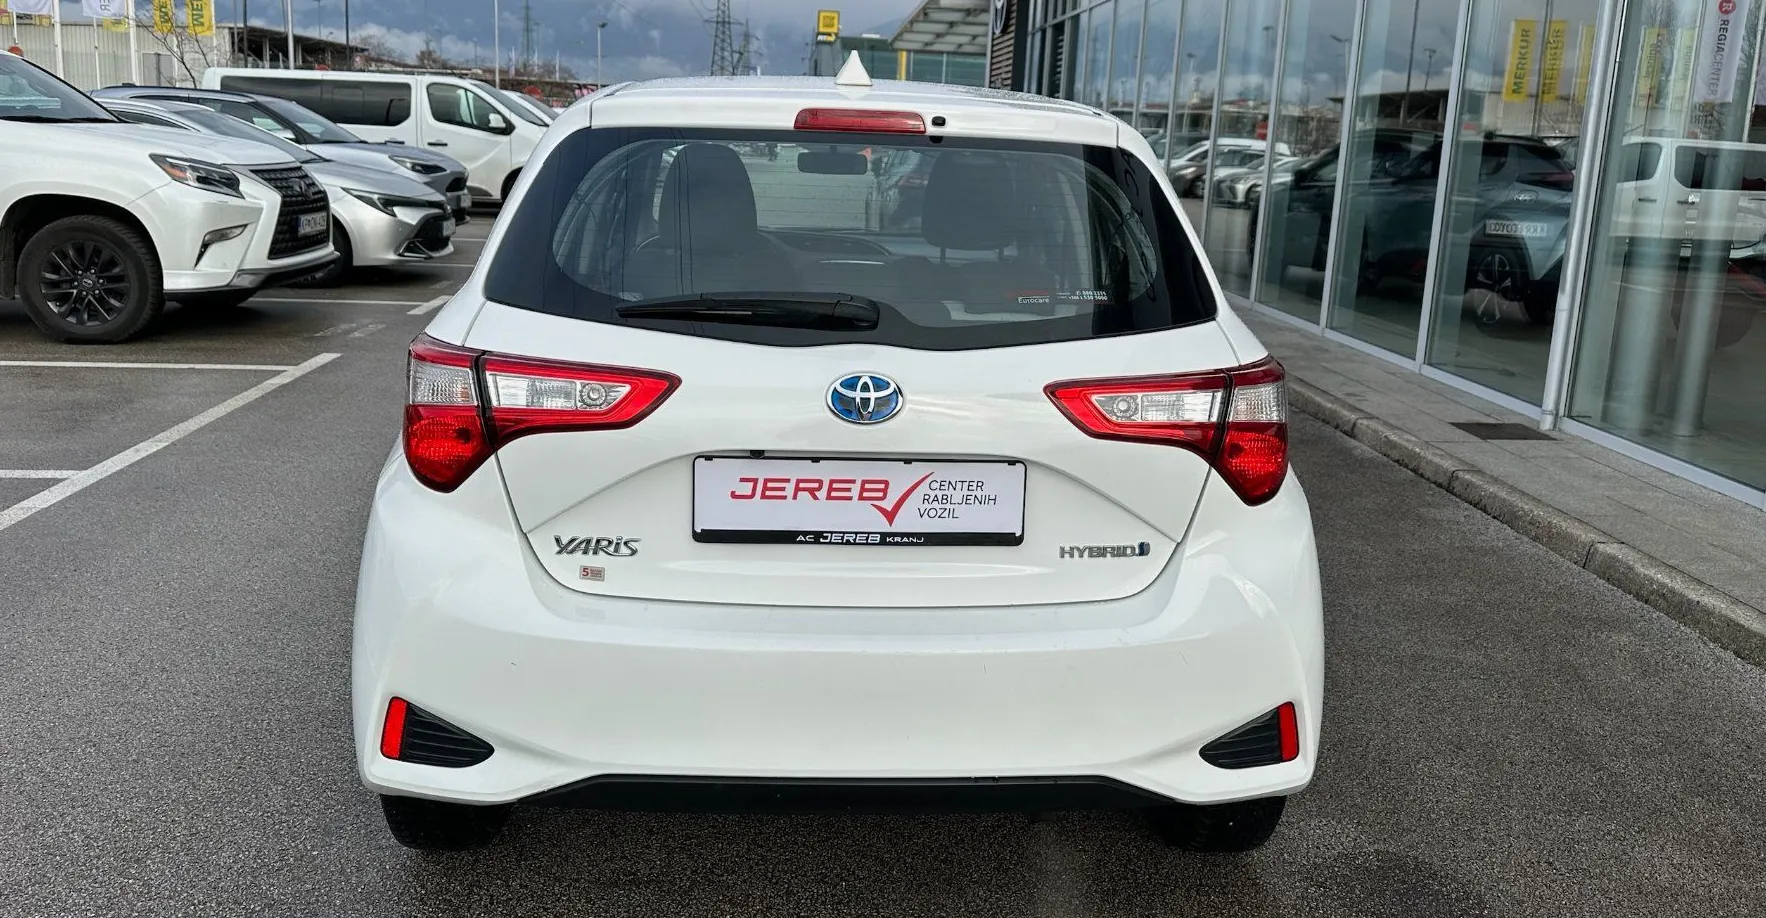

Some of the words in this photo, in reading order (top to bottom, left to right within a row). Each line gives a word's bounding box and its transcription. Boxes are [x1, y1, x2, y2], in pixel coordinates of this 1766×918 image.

[192, 0, 204, 26] ME
[1511, 27, 1531, 94] MERKUR
[730, 477, 890, 501] JEREB
[928, 480, 985, 492] CENTER
[922, 494, 998, 506] RABLJENIH
[917, 507, 960, 519] VOZIL
[796, 534, 815, 542] AC
[820, 533, 881, 544] JEREB
[1059, 545, 1137, 559] HYBRID
[581, 567, 589, 577] 5
